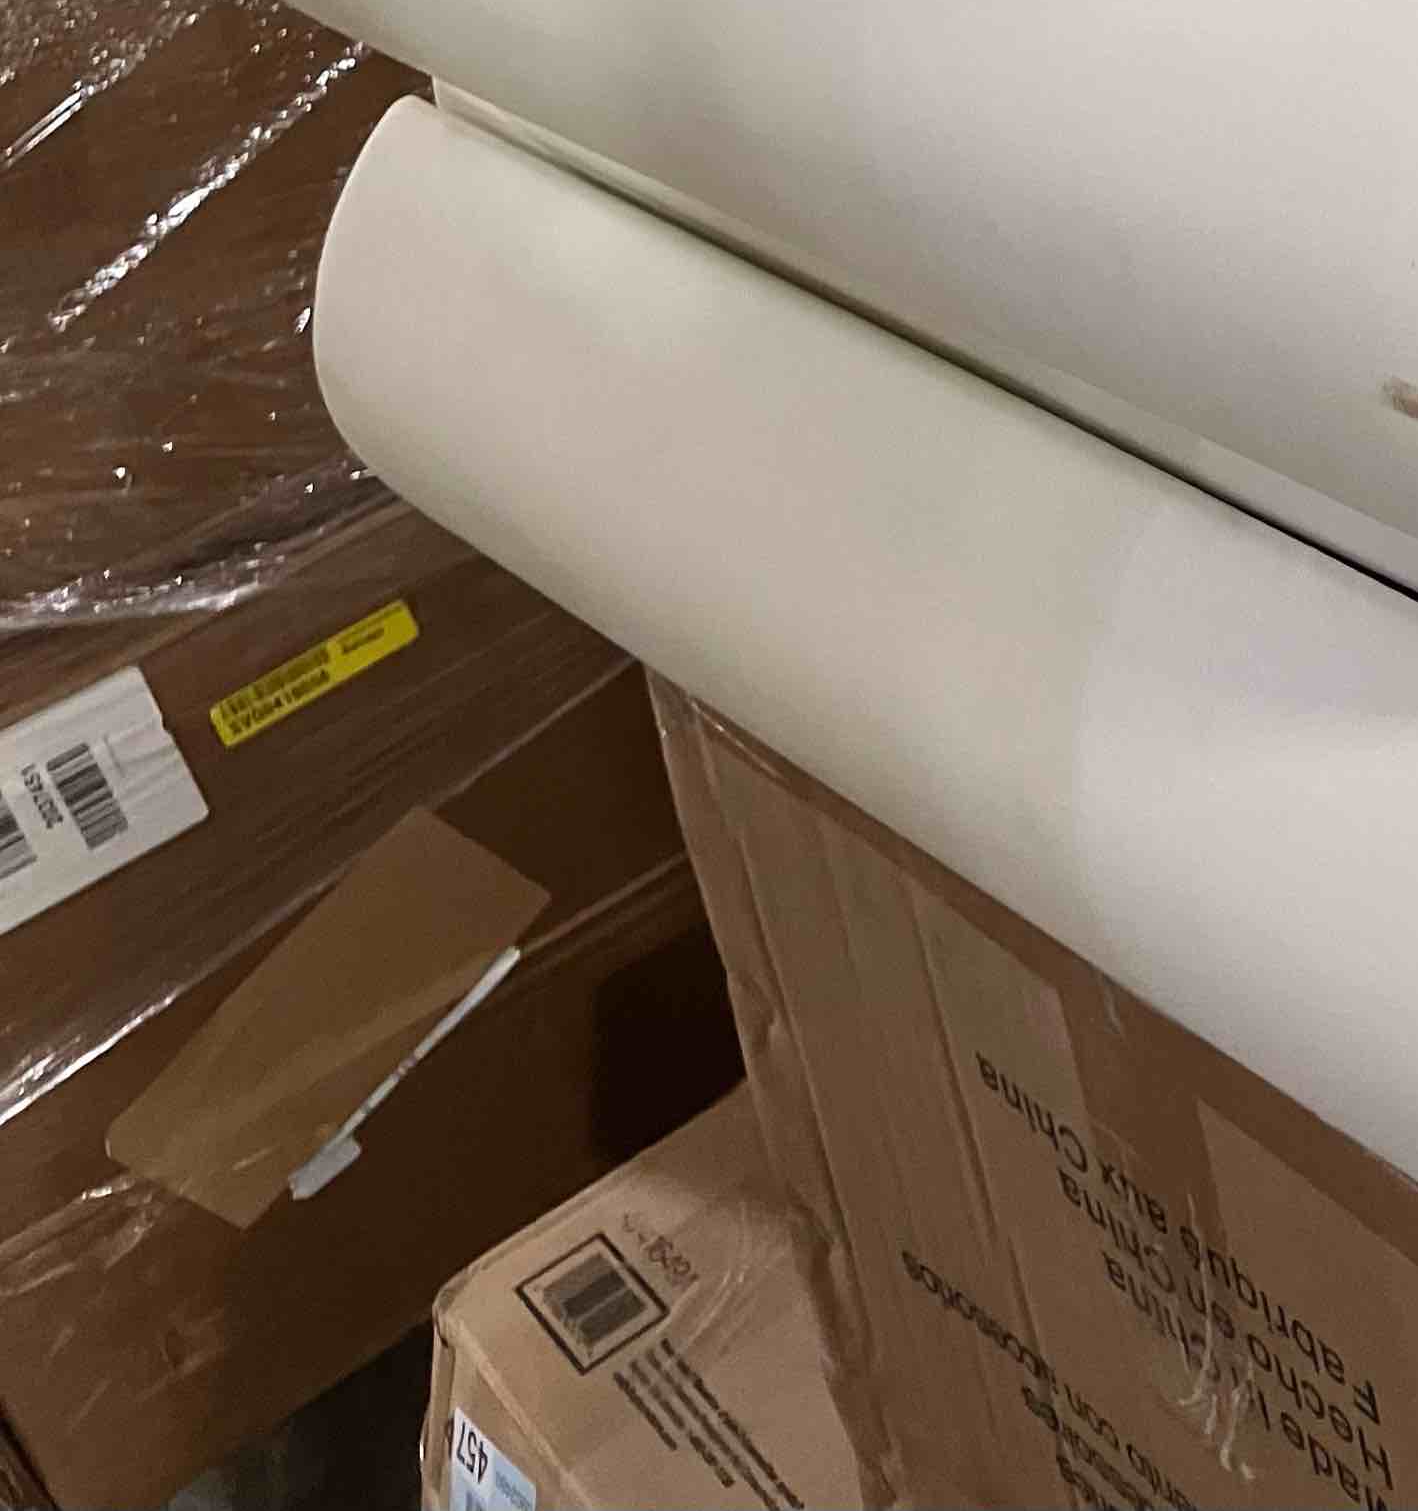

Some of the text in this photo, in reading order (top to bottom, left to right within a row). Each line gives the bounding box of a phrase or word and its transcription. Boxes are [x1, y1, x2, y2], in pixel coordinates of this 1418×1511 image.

[975, 1050, 1088, 1173] China
[1057, 1166, 1177, 1294] China
[1099, 1160, 1168, 1234] aux
[1183, 1274, 1235, 1339] en
[456, 1421, 489, 1485] 457
[1246, 1332, 1395, 1491] Hecho
